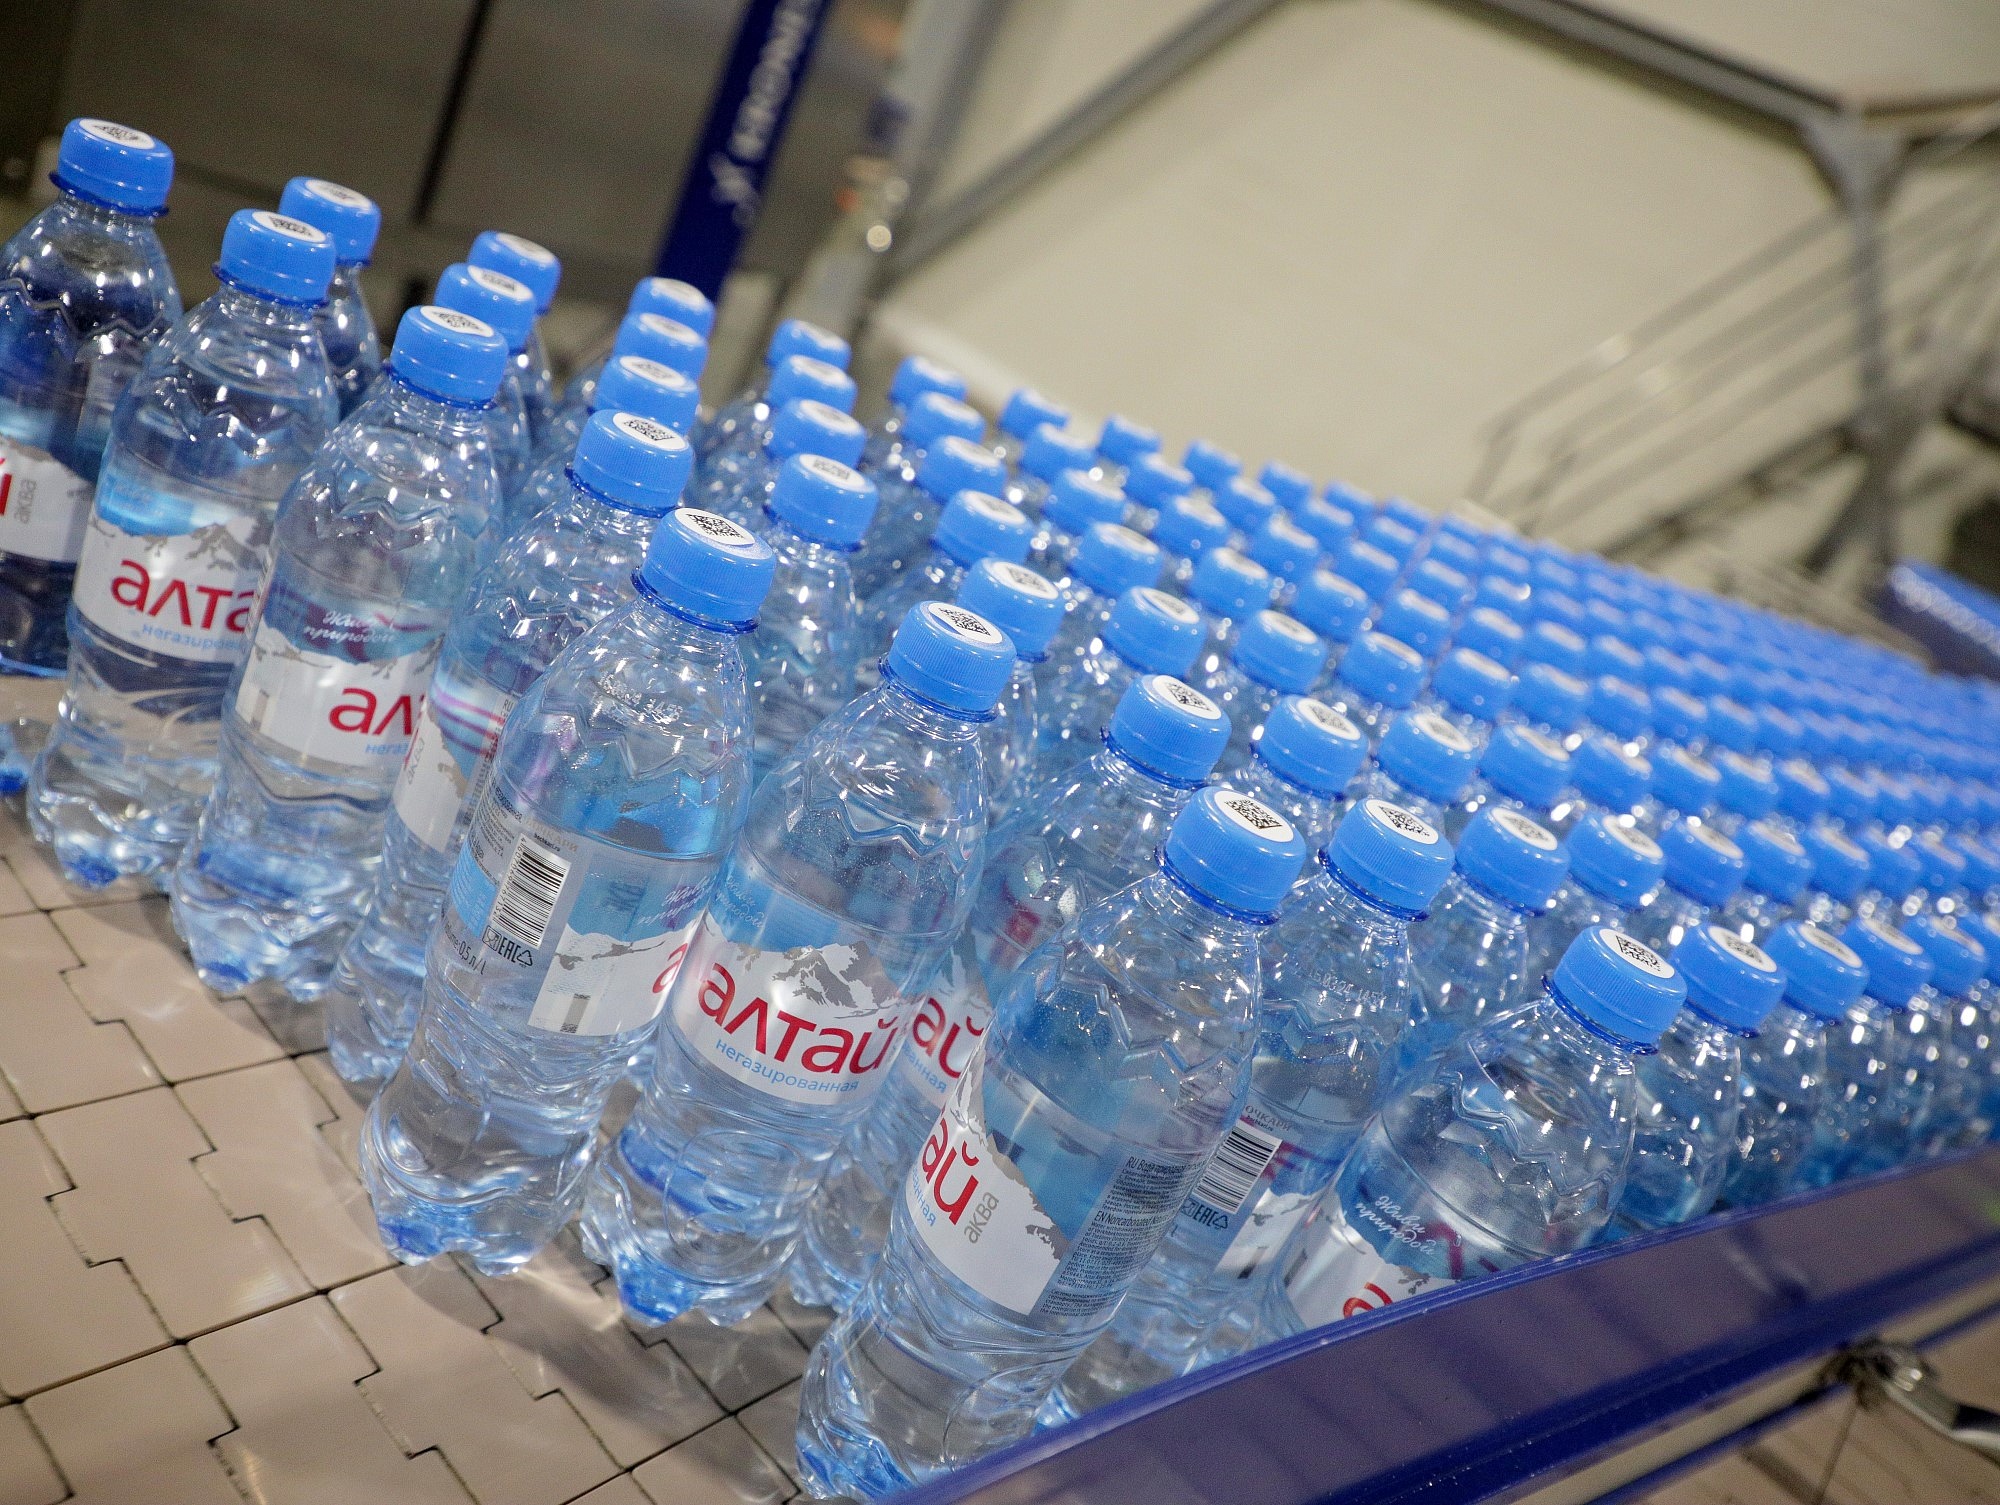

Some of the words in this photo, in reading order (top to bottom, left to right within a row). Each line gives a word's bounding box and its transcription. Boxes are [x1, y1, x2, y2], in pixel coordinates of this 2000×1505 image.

[110, 559, 256, 634] алта
[328, 687, 413, 737] ал
[698, 961, 899, 1076] алтай
[911, 996, 986, 1080] ай
[715, 1037, 861, 1094] негазированная
[1244, 1104, 1292, 1132] ОЧКАРИ
[920, 1115, 981, 1227] ай
[963, 1190, 1000, 1245] аква
[1355, 1202, 1437, 1255] природой
